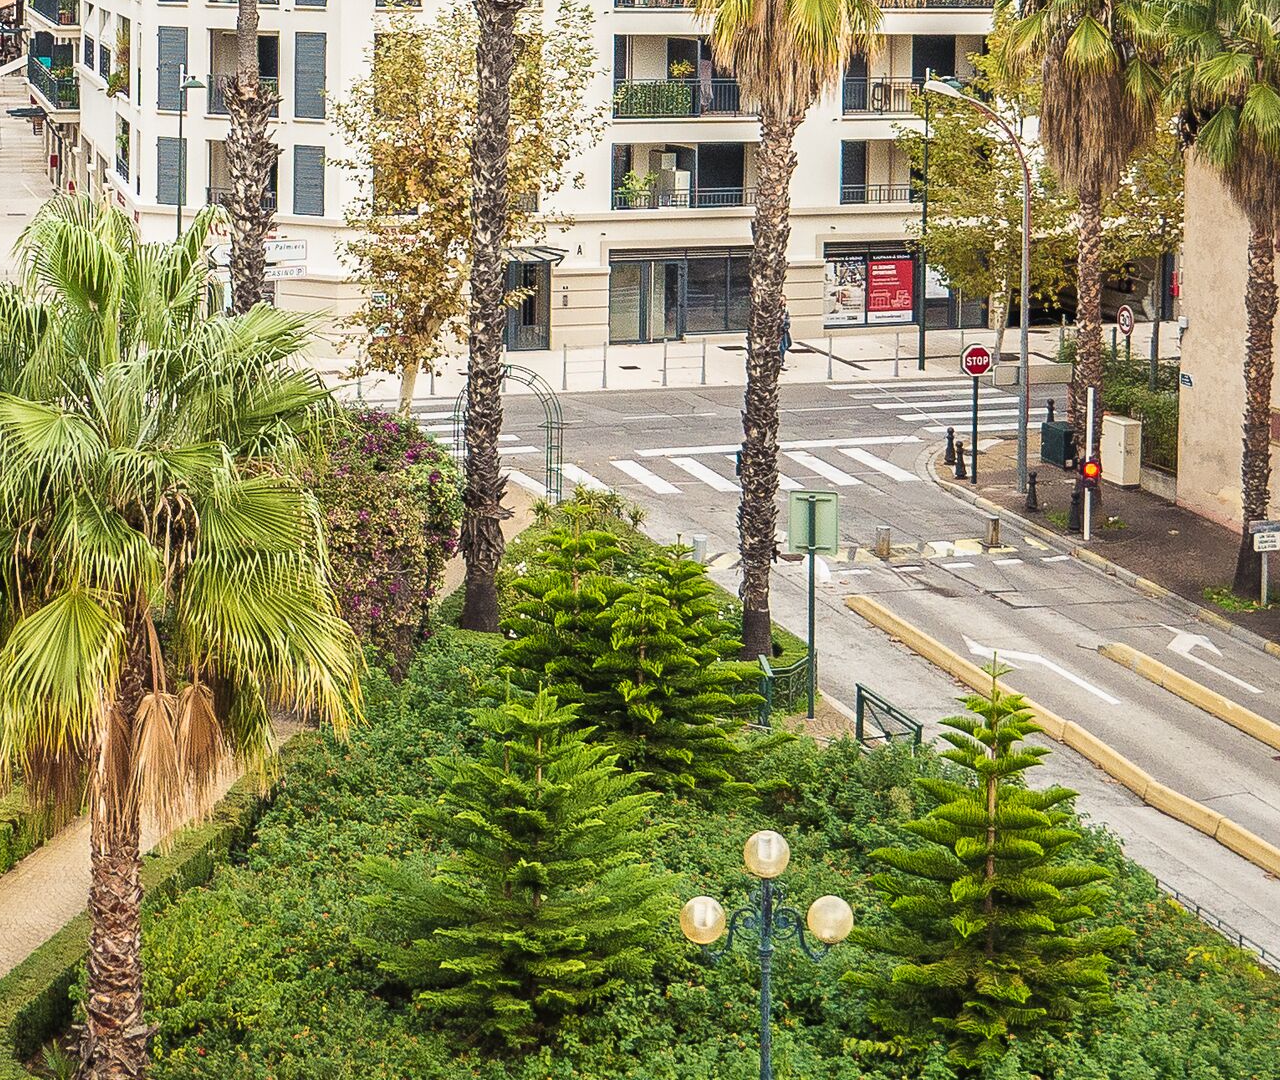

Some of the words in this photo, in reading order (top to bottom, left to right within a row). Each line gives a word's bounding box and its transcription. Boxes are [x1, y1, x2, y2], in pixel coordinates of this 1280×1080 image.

[274, 243, 305, 251] Palmiers
[576, 244, 583, 256] A
[1120, 312, 1130, 328] 30
[966, 356, 989, 366] STOP
